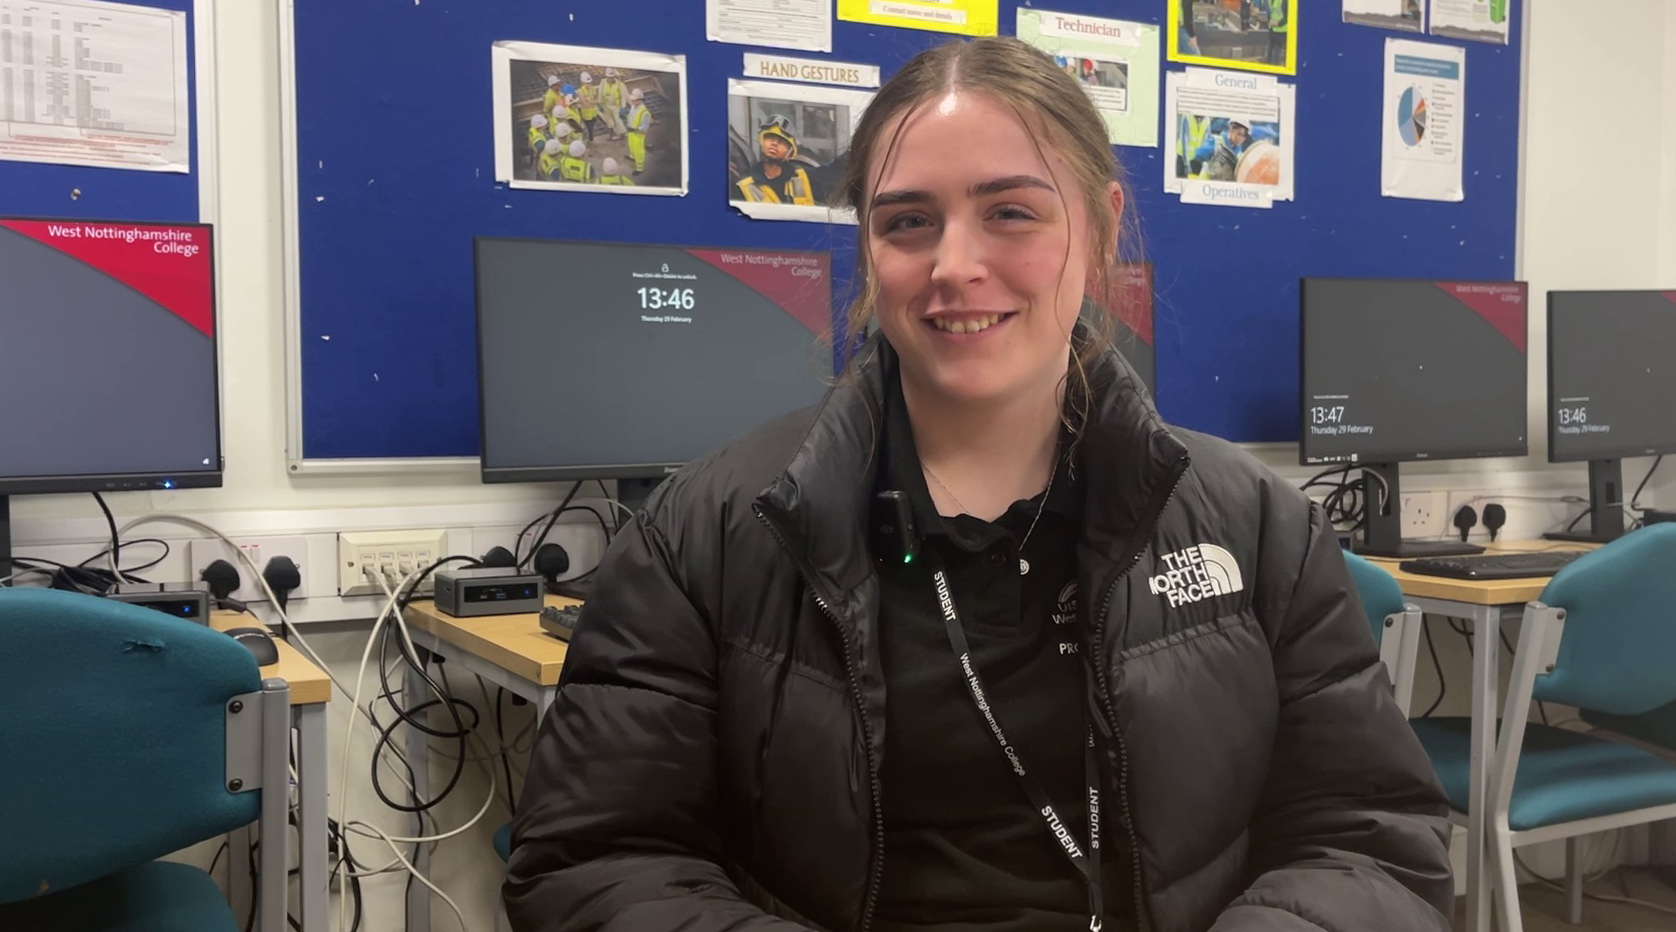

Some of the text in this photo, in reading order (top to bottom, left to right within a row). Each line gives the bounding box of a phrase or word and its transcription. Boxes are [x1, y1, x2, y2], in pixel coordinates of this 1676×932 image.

[1055, 17, 1121, 38] Technician
[760, 60, 860, 84] HAND GESTURES
[1215, 73, 1258, 90] General
[1202, 183, 1260, 202] Operatives
[48, 224, 192, 243] West Nottinghamshire
[153, 241, 200, 258] College
[720, 253, 818, 268] West Nottinghamshire
[791, 266, 822, 280] College
[637, 287, 695, 310] 13:46
[1310, 405, 1345, 424] 13:47
[1558, 406, 1587, 425] 13:46
[1310, 424, 1374, 436] Thursday 29 February
[1161, 546, 1202, 570] THE
[934, 570, 957, 622] STUDENT
[1166, 580, 1215, 608] FACE
[960, 652, 1026, 777] West Nottinghamshire College
[1088, 786, 1100, 850] STUDENT
[1041, 805, 1083, 860] STUDENT
